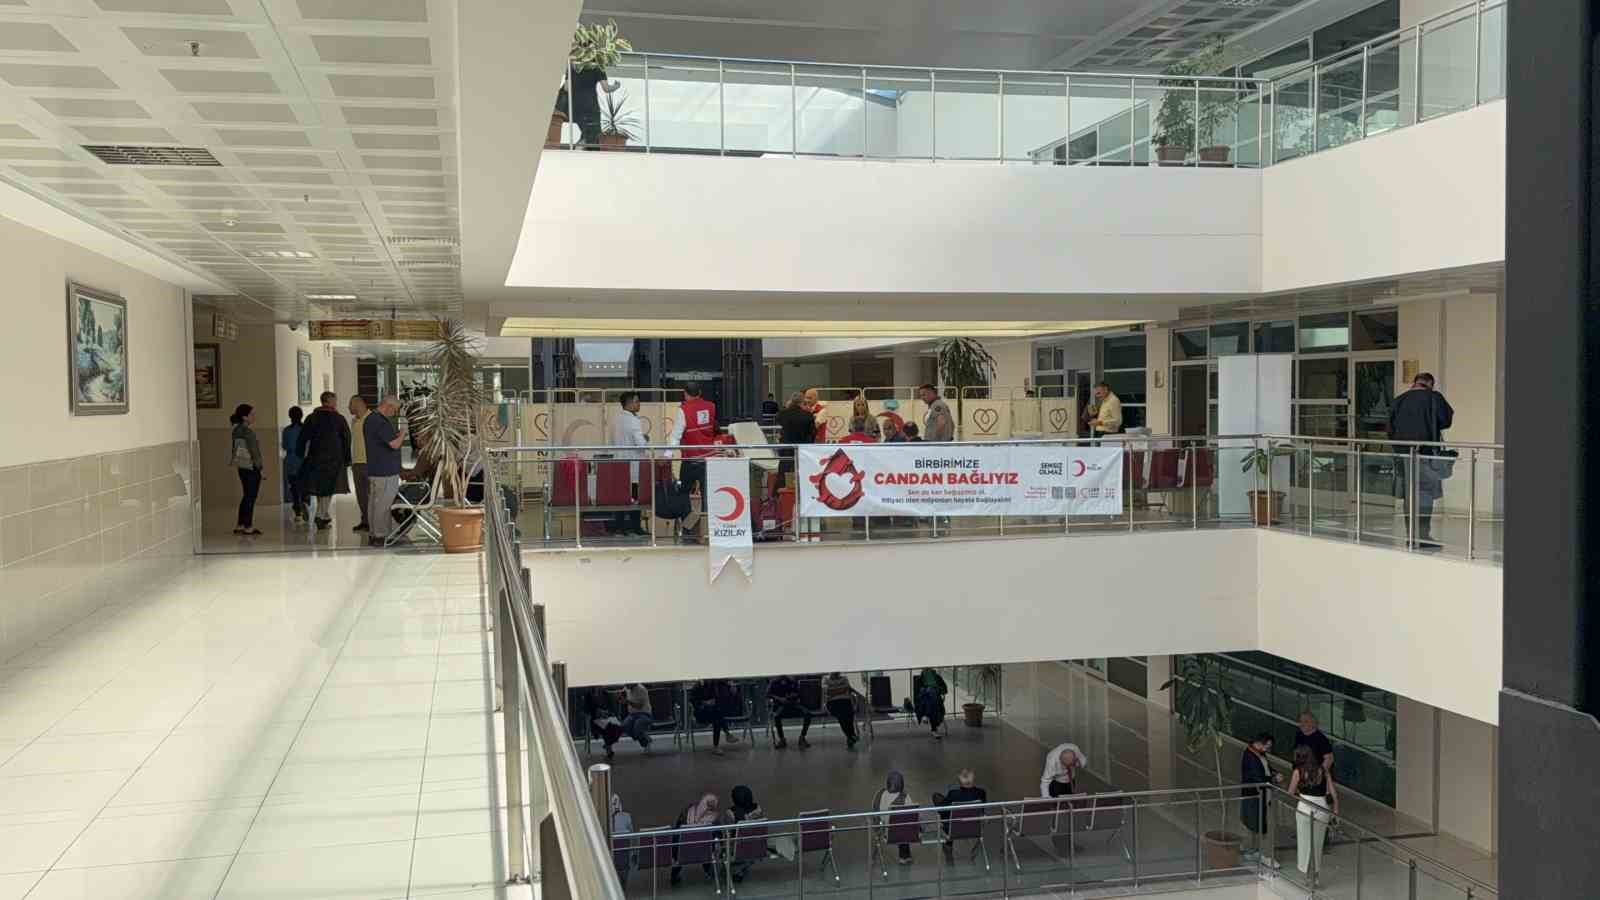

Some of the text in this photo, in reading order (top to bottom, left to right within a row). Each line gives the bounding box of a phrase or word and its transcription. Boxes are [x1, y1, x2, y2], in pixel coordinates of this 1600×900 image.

[914, 457, 980, 469] BİRBİRİMİZE
[874, 470, 1019, 485] CANDAN BAĞLIYIZ
[714, 529, 746, 537] KIZILAY
